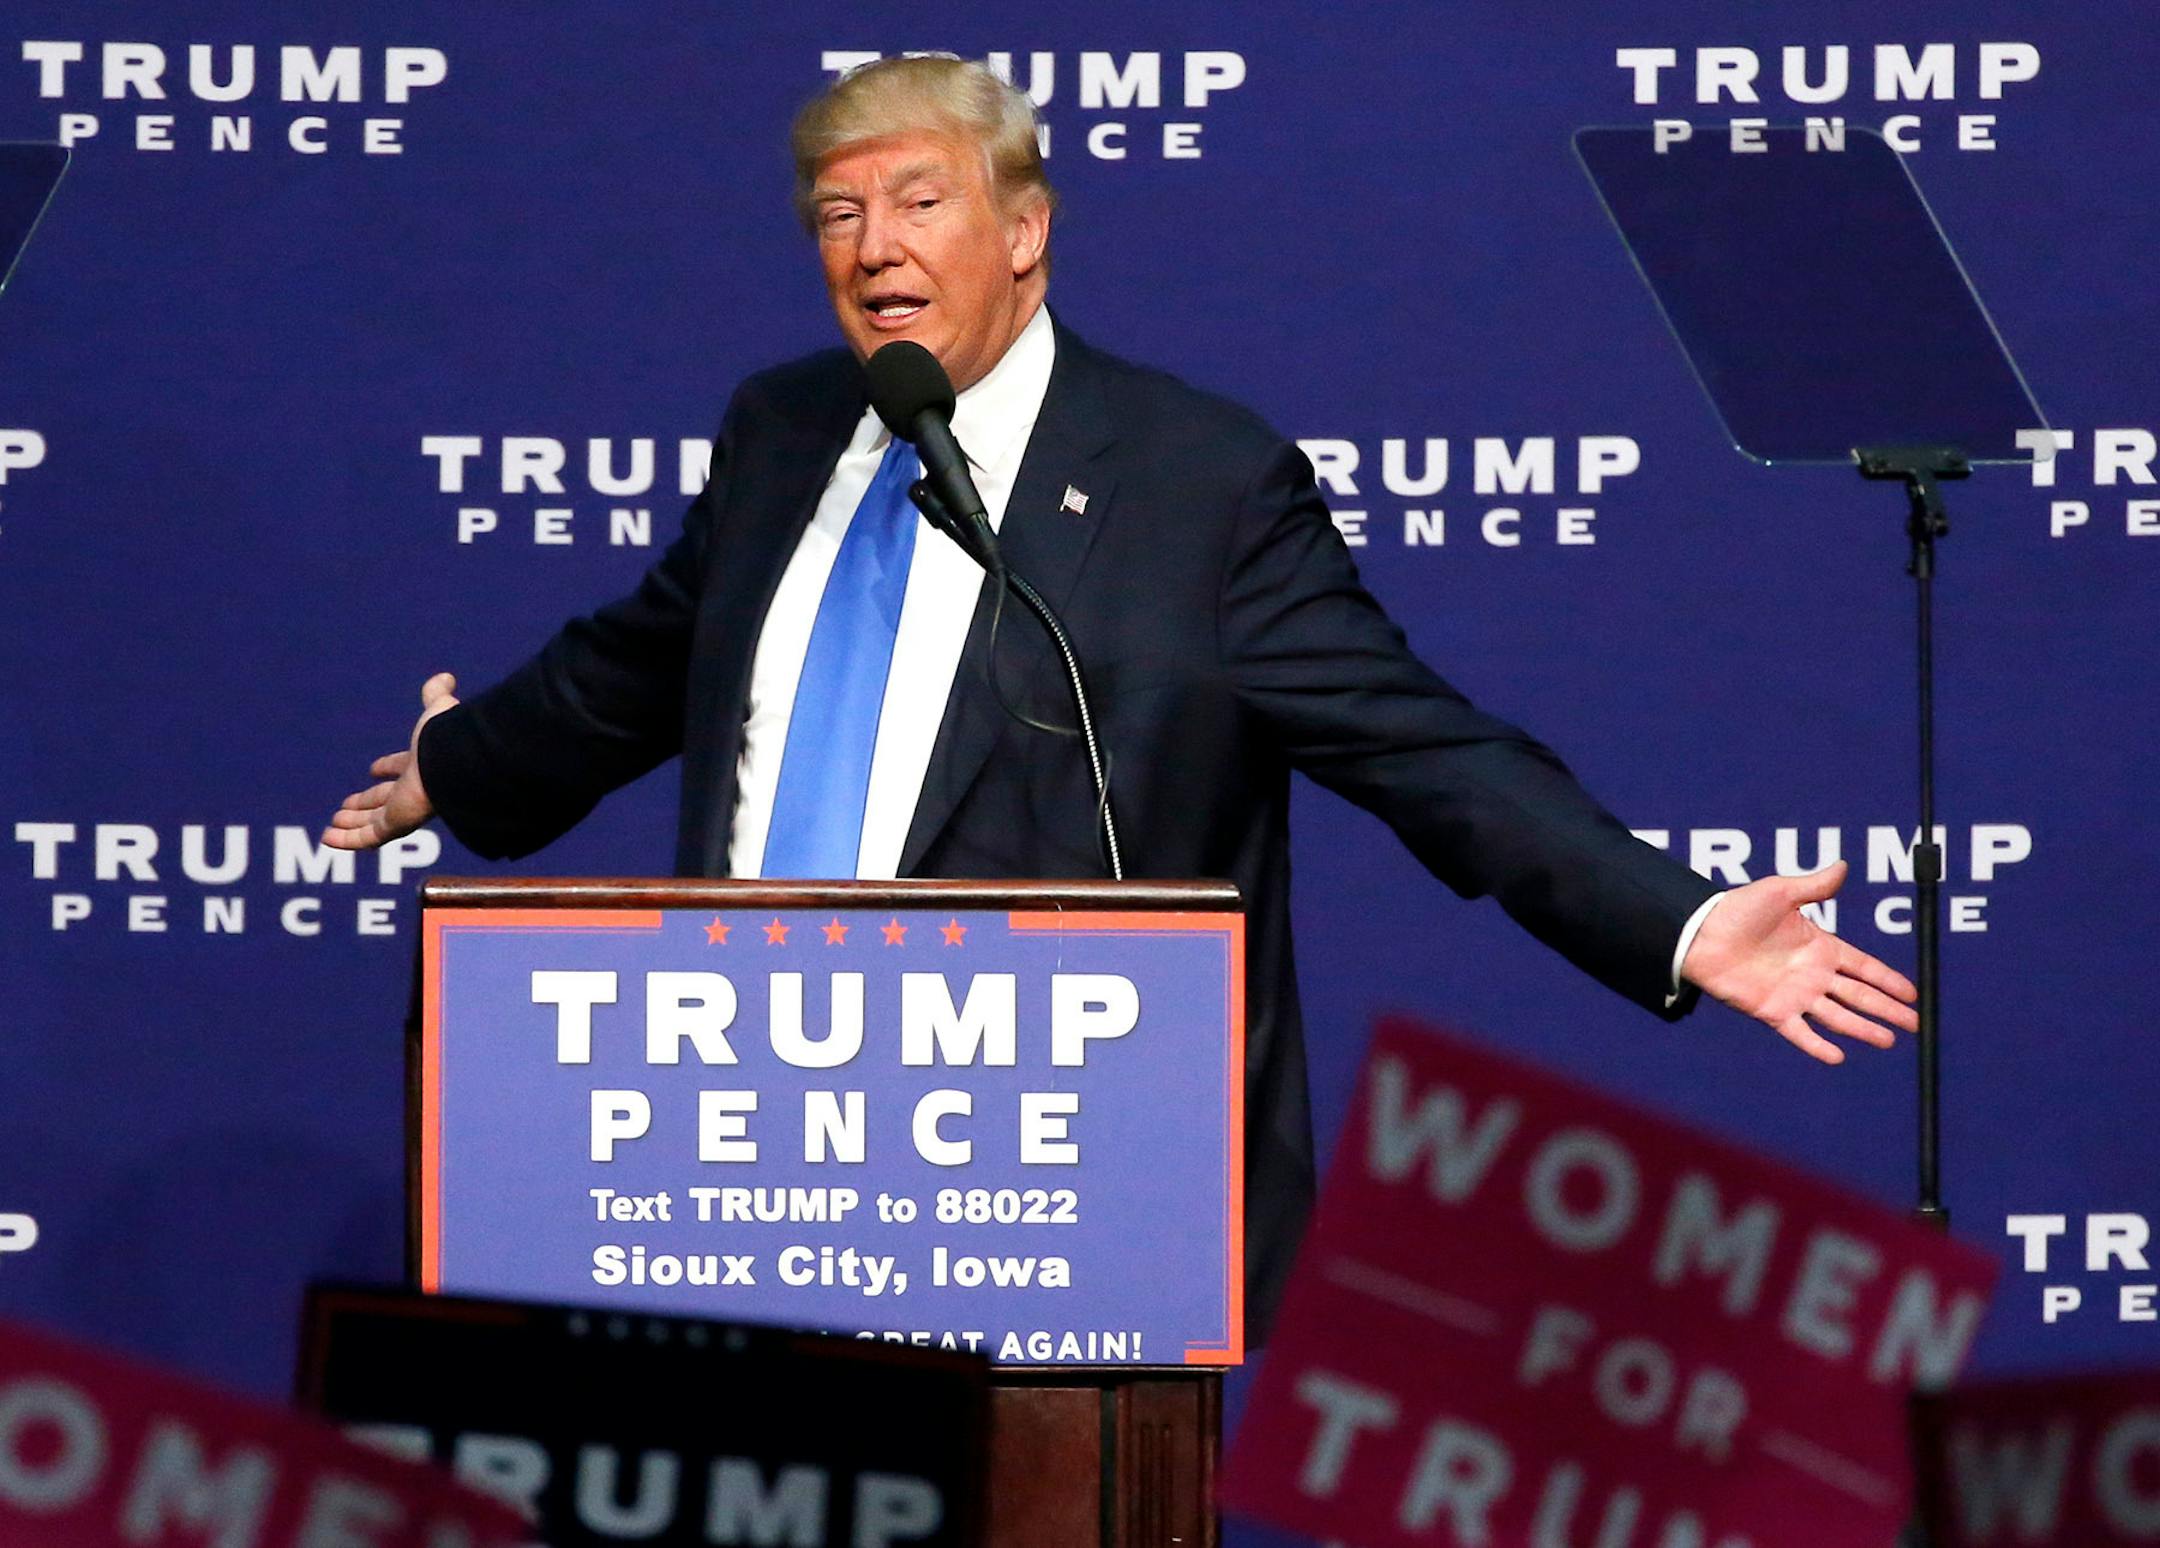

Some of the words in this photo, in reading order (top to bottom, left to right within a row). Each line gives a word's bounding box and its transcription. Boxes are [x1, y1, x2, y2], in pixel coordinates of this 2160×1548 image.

[22, 41, 447, 103] TRUMP
[1616, 42, 2041, 104] TRUMP
[59, 113, 403, 154] PENCE
[1653, 114, 1996, 153] PENCE
[421, 436, 713, 496] TRU
[1295, 436, 1640, 497] RUMP
[458, 508, 651, 546] PEN
[1329, 508, 1596, 547] ENCE
[15, 822, 441, 884] TRUMP
[1630, 825, 2032, 884] RUMP
[52, 894, 396, 936] PENCE
[1798, 896, 1987, 935] NCE
[530, 969, 1141, 1068] TRUMP
[589, 1088, 1080, 1166] PENCE
[589, 1187, 673, 1223] Text
[688, 1186, 860, 1224] TRUMP
[875, 1192, 918, 1224] to
[935, 1187, 1079, 1225] 88022
[1362, 1053, 1988, 1393] WOMEN
[591, 1244, 757, 1287] Sioux
[777, 1245, 908, 1297] City,
[932, 1246, 1071, 1289] Iowa
[998, 1330, 1143, 1361] AGAIN!
[1515, 1302, 1750, 1465] FOR
[0, 1374, 475, 1548] OME
[1294, 1372, 1758, 1548] TRU
